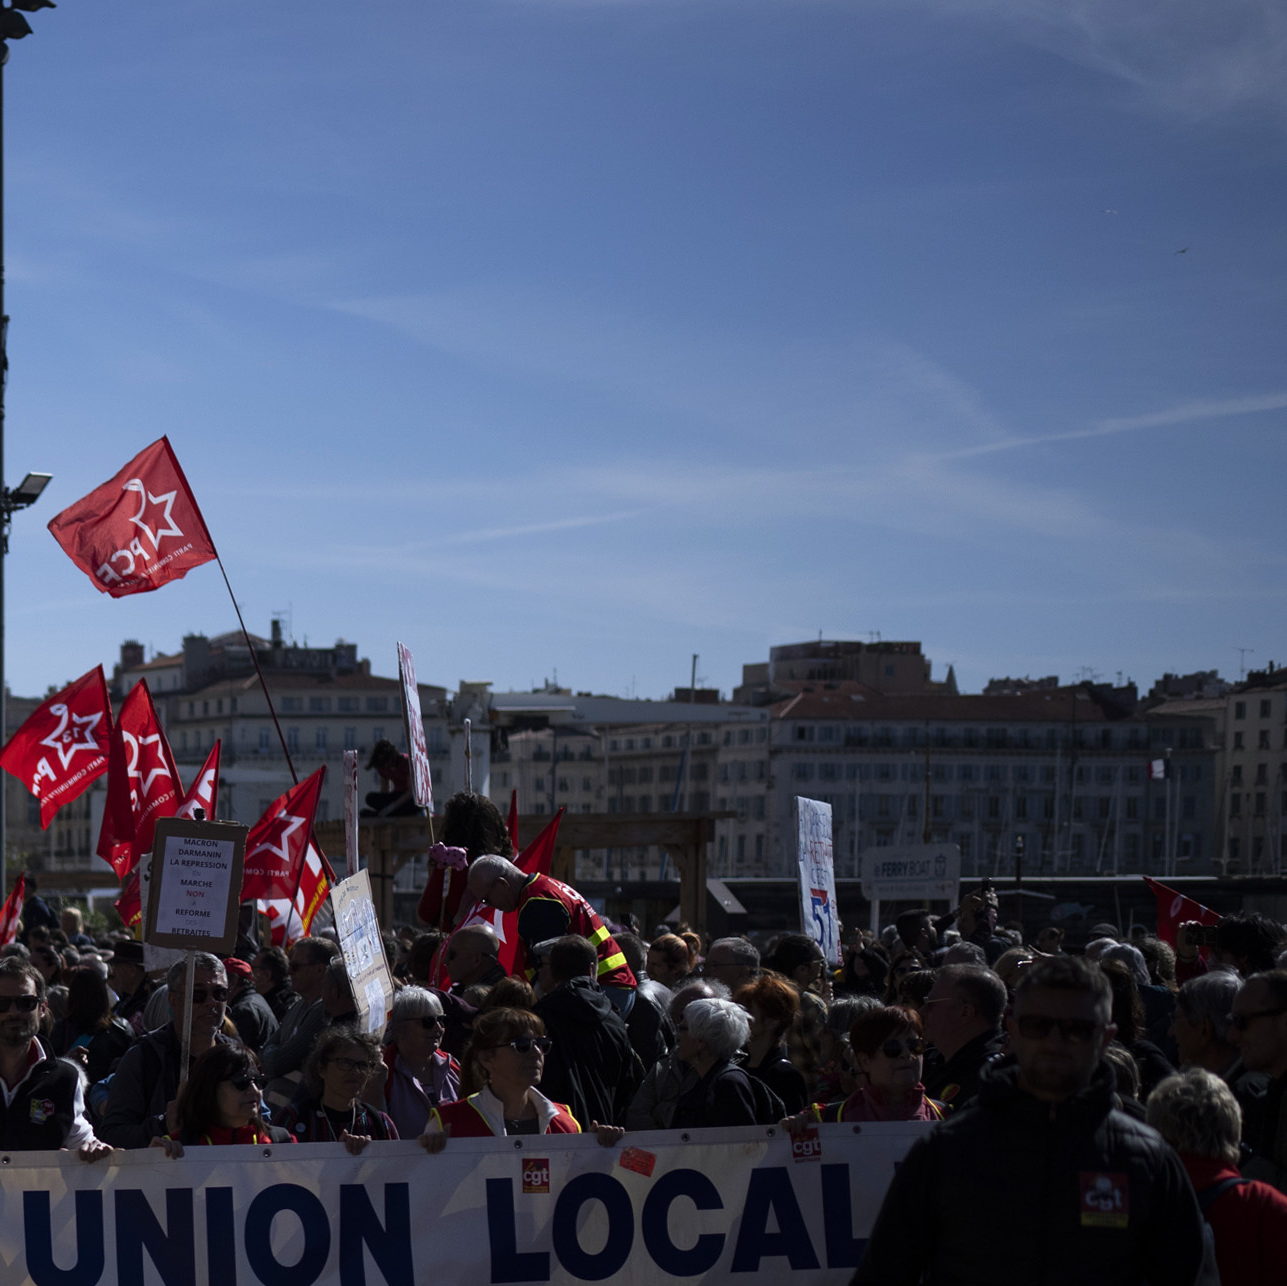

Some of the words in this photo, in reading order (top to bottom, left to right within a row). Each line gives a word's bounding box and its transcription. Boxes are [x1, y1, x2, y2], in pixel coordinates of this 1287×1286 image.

[184, 838, 218, 848] MACRON
[178, 848, 222, 858] DARMANIN
[181, 860, 228, 869] REPRESSION
[881, 861, 908, 877] FERRY
[180, 879, 213, 888] MARCHE
[186, 890, 205, 898] NON
[175, 908, 211, 918] REFORME
[171, 927, 211, 937] RETRAITES
[523, 1168, 549, 1186] cgt
[485, 1162, 907, 1285] LOCAL
